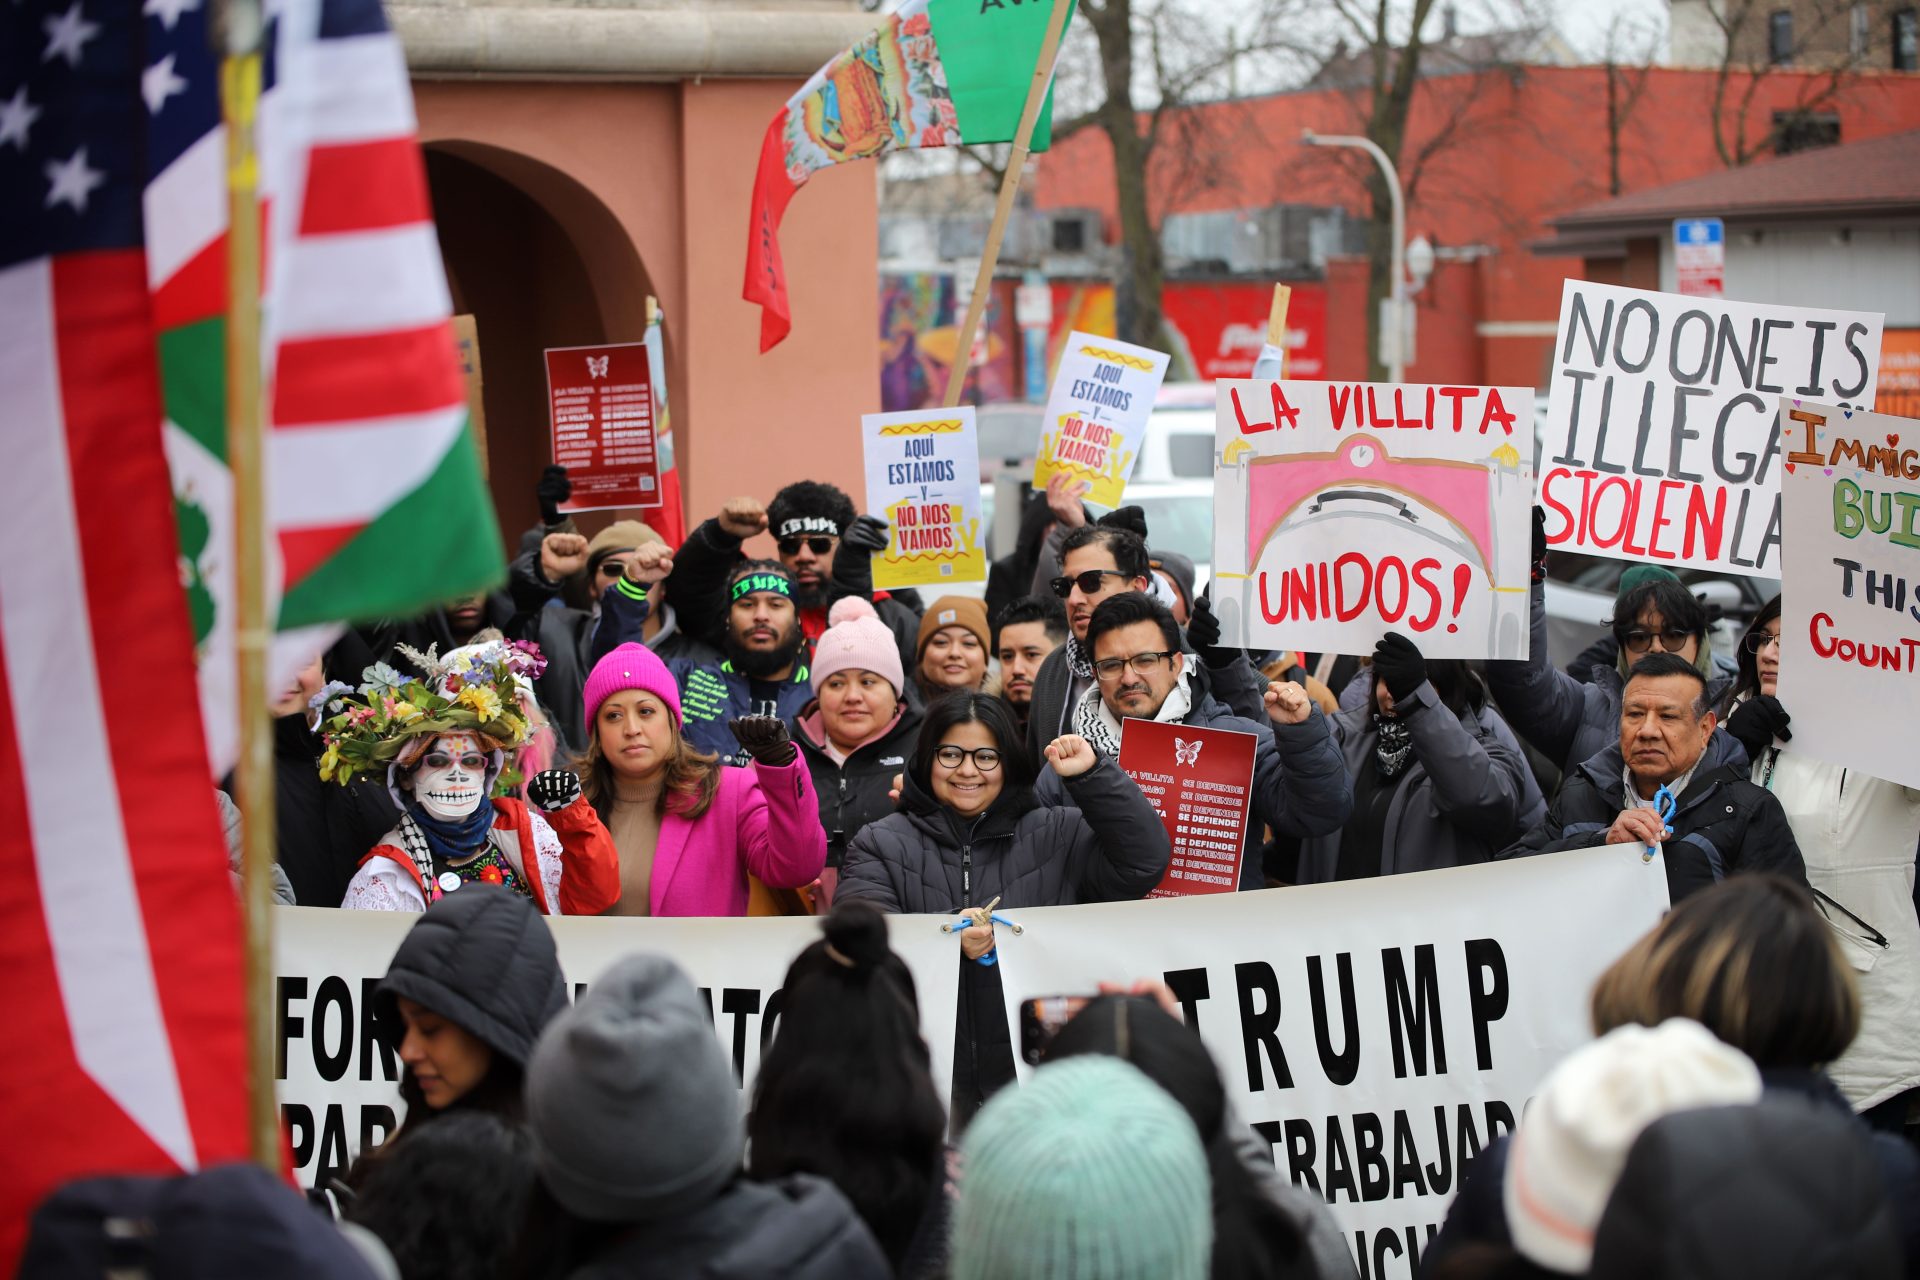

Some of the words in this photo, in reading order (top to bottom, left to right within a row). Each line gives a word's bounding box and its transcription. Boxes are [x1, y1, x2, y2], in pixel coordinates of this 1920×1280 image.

[1562, 292, 1660, 373] NO
[1668, 309, 1795, 393] ONE
[1795, 321, 1869, 399] IS
[1093, 363, 1125, 384] AQUÍ
[1070, 379, 1133, 412] ESTAMOS
[1093, 406, 1101, 420] Y
[1231, 382, 1300, 435] LA
[1328, 384, 1516, 436] VILLITA
[1063, 418, 1084, 438] NO
[1083, 422, 1113, 447] NOS
[1551, 369, 1781, 486] ILLEG
[905, 433, 934, 460] AQUÍ
[1058, 438, 1106, 468] VAMOS
[888, 460, 955, 485] ESTAMOS
[920, 486, 928, 500] Y
[897, 506, 917, 527] NO
[921, 504, 951, 525] NOS
[1541, 467, 1727, 561] STOLEN
[899, 527, 953, 551] VAMOS
[1259, 552, 1472, 634] UNIDOS!
[1139, 771, 1174, 784] VILLITA
[1183, 778, 1195, 788] SE
[1196, 781, 1244, 795] DEFIENDE!
[1179, 803, 1191, 812] SE
[1193, 805, 1241, 819] DEFIENDE!
[1181, 791, 1193, 800] SE
[1195, 793, 1242, 807] DEFIENDE!
[1176, 825, 1188, 834] SE
[1190, 827, 1238, 840] DEFIENDE!
[1178, 813, 1190, 822] SE
[1192, 815, 1239, 828] DEFIENDE!
[1173, 846, 1185, 855] SE
[1175, 837, 1187, 846] SE
[1189, 839, 1236, 852] DEFIENDE!
[1170, 869, 1182, 879] SE
[1172, 858, 1184, 867] SE
[1163, 938, 1509, 1092] TRUMP
[1250, 1097, 1535, 1205] TRABAJA
